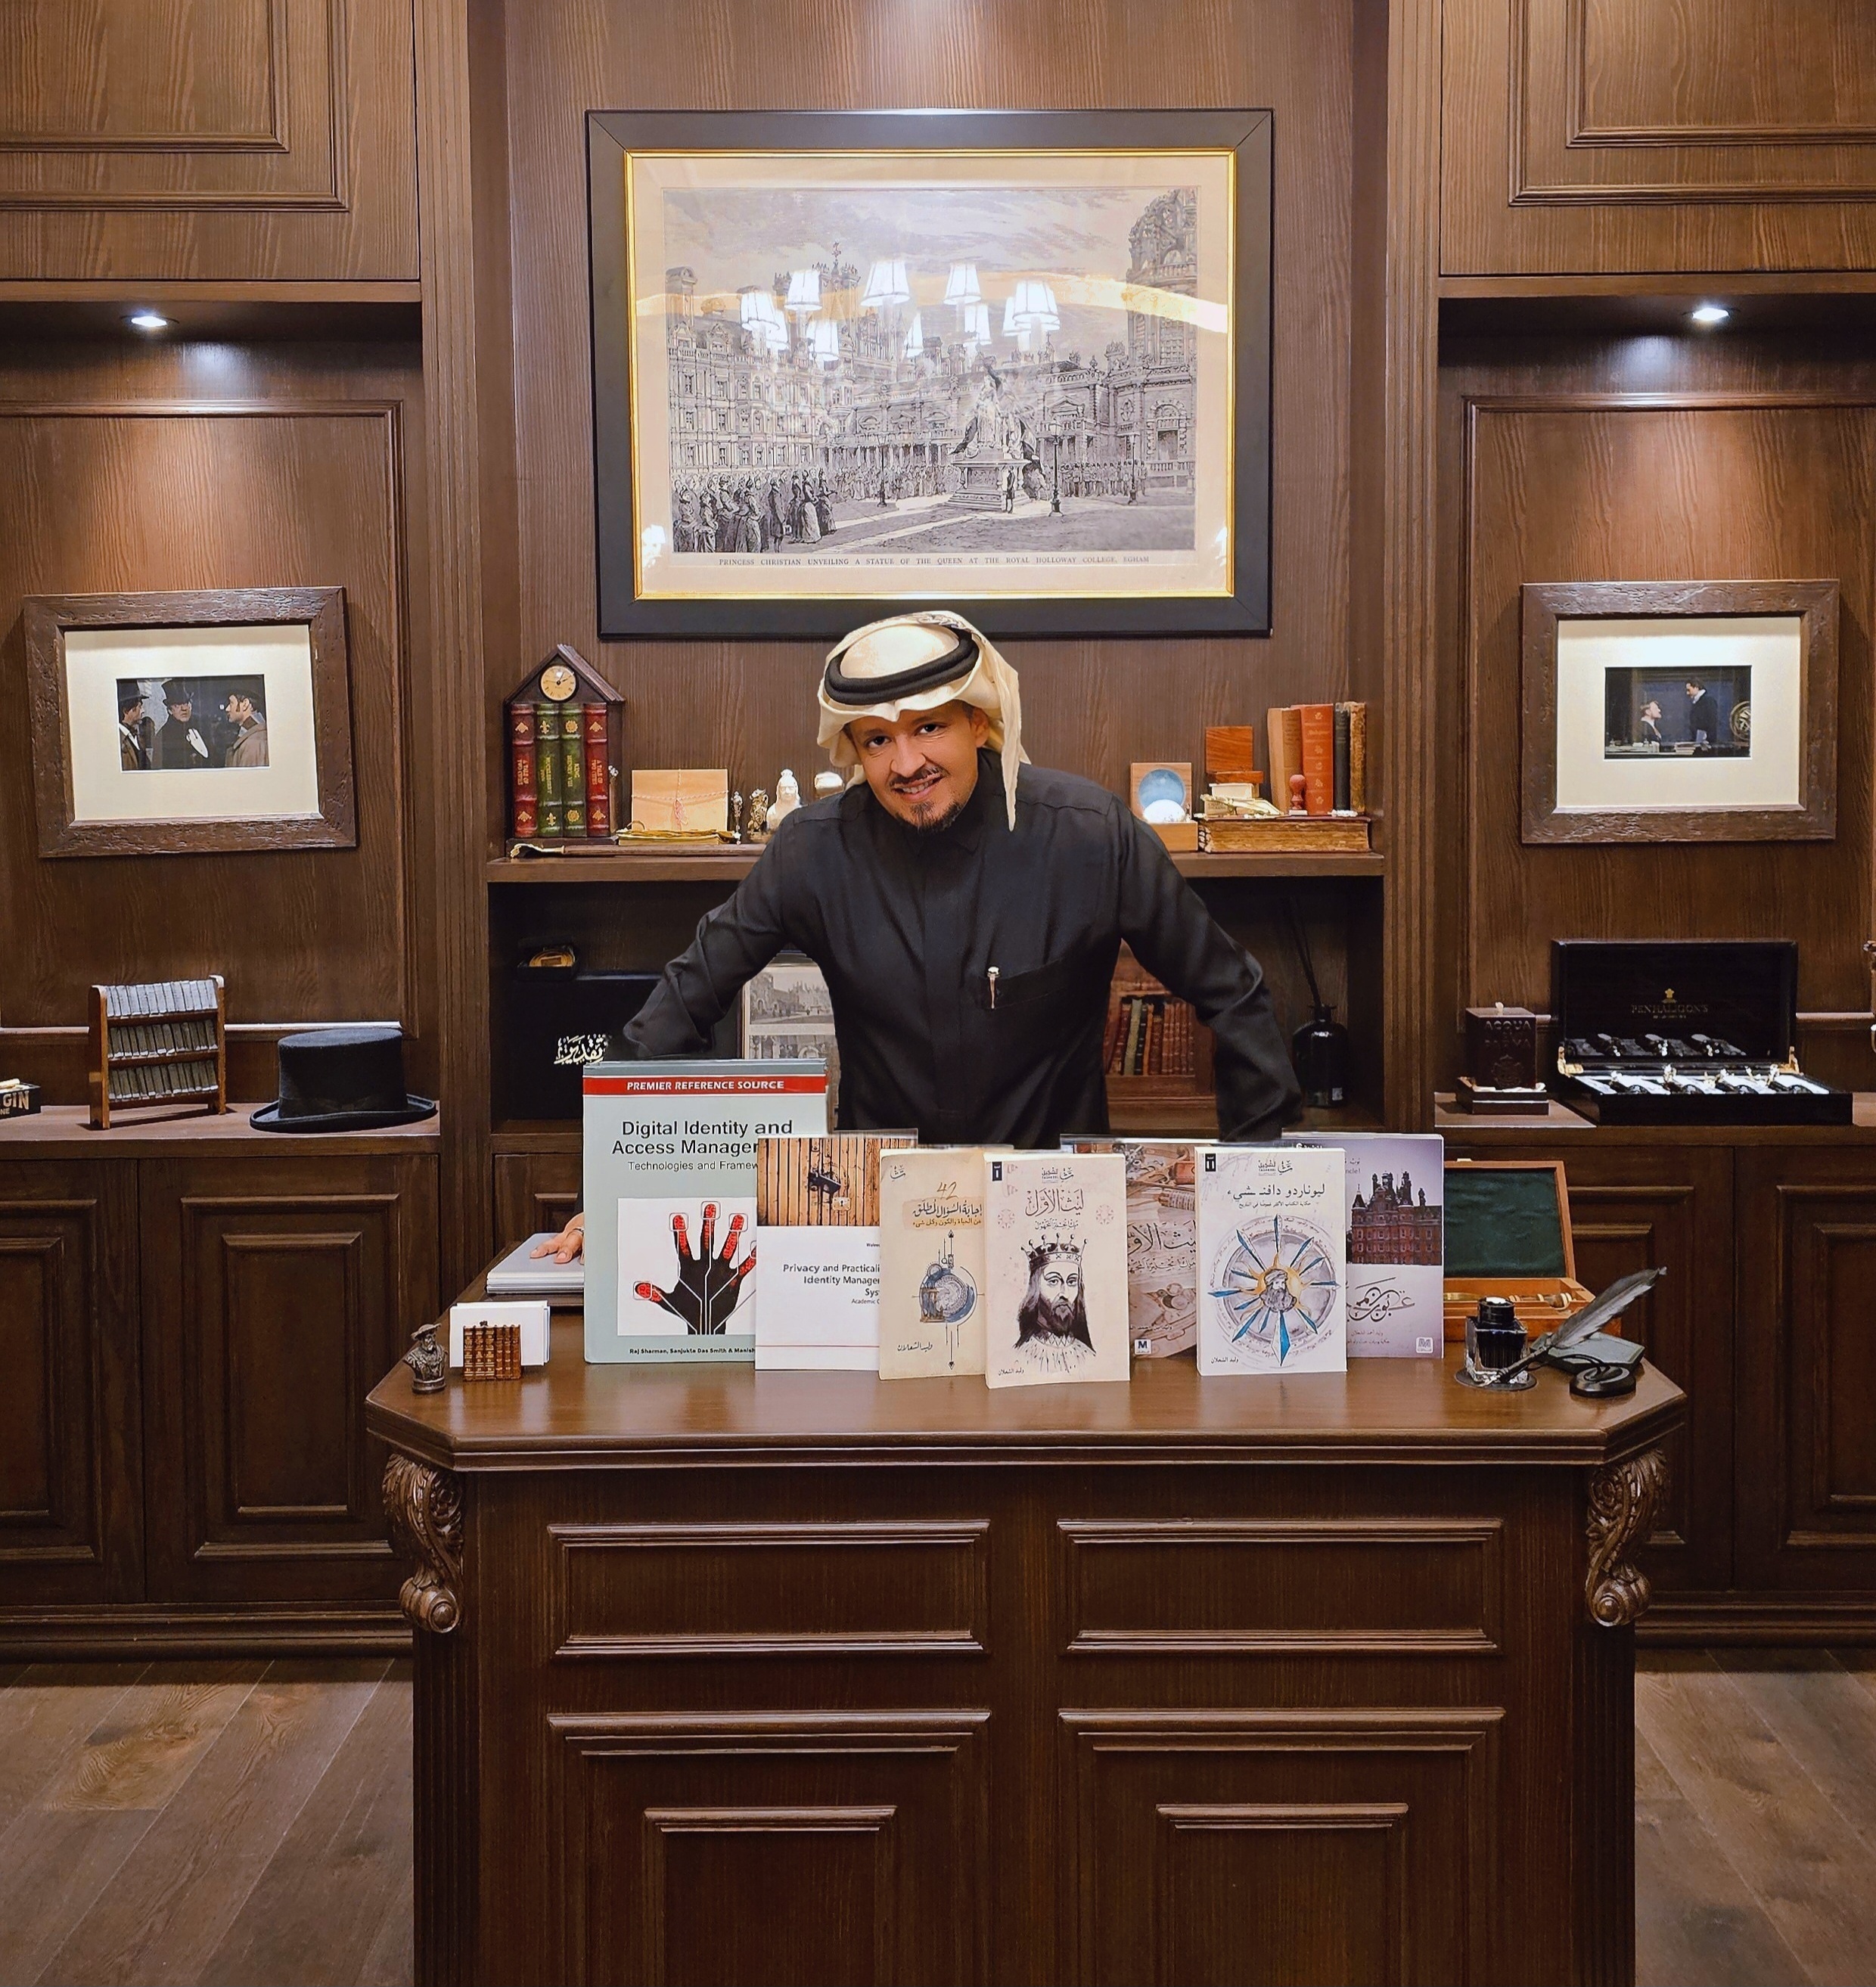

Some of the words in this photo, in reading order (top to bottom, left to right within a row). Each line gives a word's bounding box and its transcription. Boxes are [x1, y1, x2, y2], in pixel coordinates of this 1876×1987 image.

[937, 557, 963, 566] QUEEN
[626, 1082, 672, 1091] PREMIER
[675, 1081, 735, 1090] REFERENCE
[738, 1080, 784, 1089] SOURCE
[3, 1090, 30, 1110] GIN
[623, 1120, 678, 1138] Digital
[685, 1119, 749, 1138] Identity
[755, 1119, 793, 1135] and
[612, 1140, 675, 1154] Access
[628, 1161, 694, 1172] Technologies
[697, 1161, 716, 1169] and
[936, 1181, 958, 1200] 42
[1285, 1183, 1325, 1198] ليوناردو
[783, 1264, 820, 1274] Privacy
[803, 1275, 840, 1285] Identity
[921, 1341, 933, 1352] وليد
[1138, 1340, 1148, 1349] M
